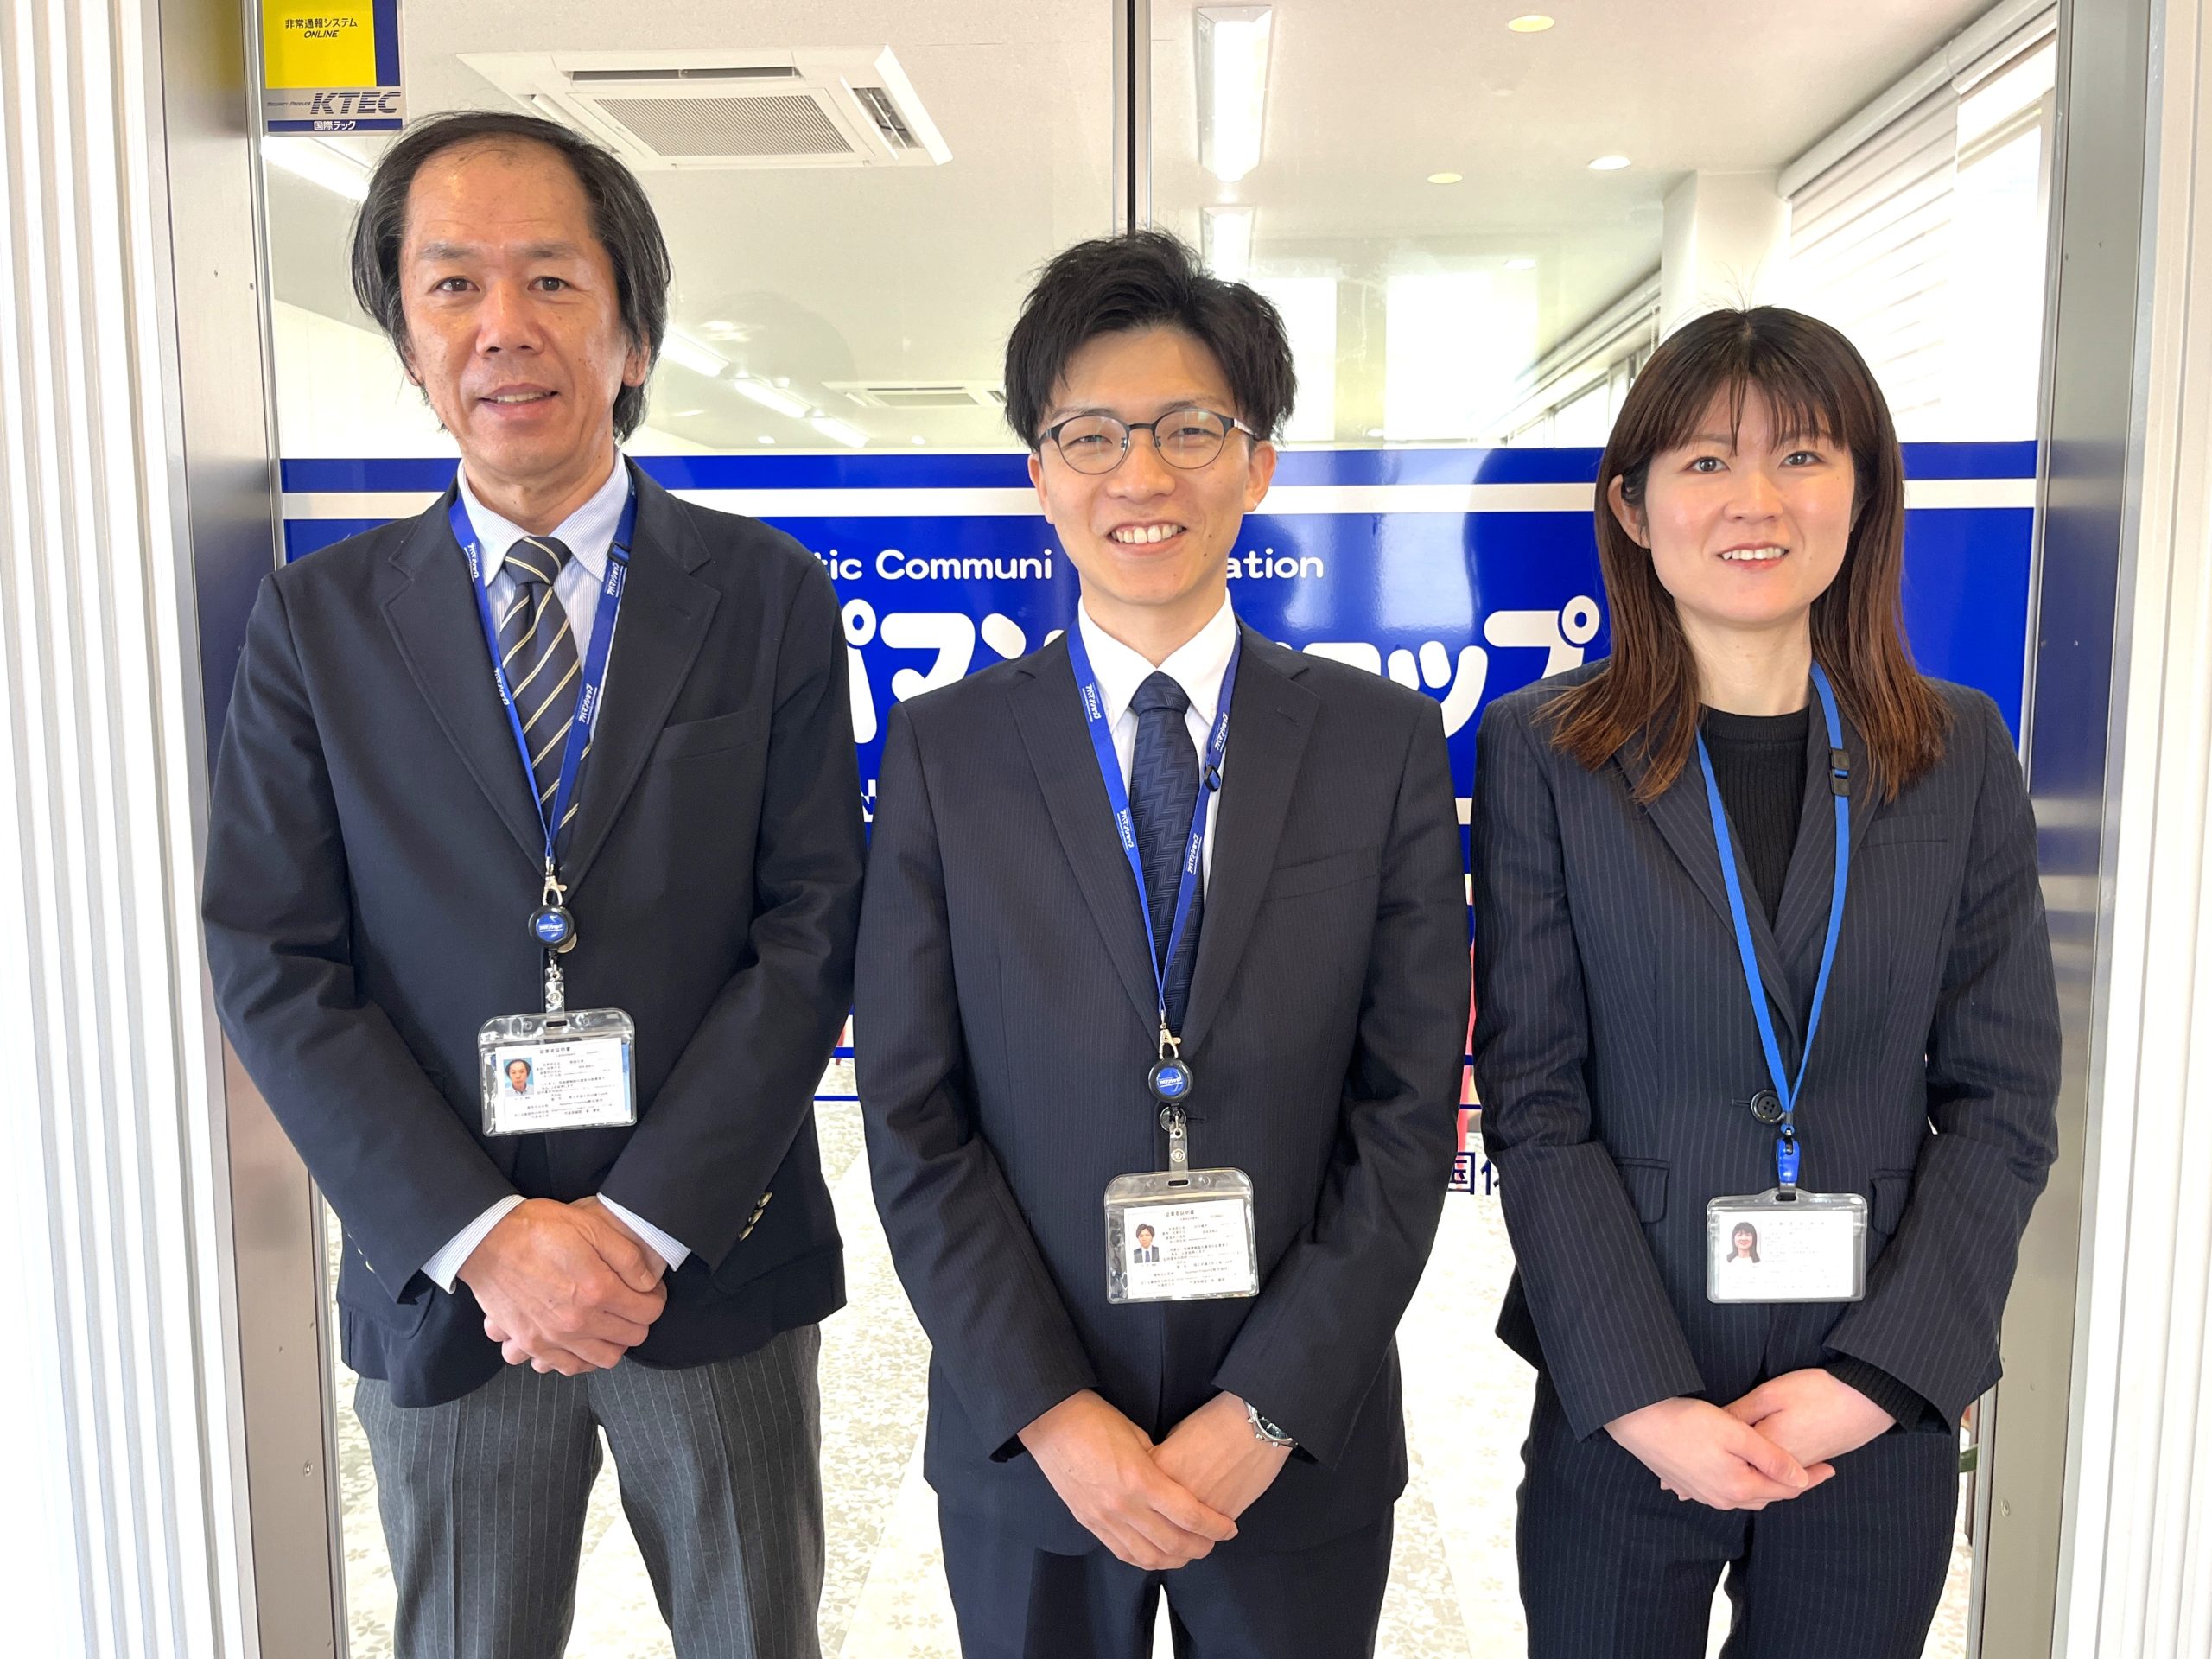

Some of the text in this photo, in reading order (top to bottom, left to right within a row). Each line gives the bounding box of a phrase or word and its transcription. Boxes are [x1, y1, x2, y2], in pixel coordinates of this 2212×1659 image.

[285, 17, 358, 29] 非常通報システム
[310, 92, 402, 115] KTEC
[314, 120, 356, 131] 国際テック
[875, 548, 1052, 580] Communi
[1226, 547, 1324, 579] ation
[579, 683, 594, 723] アパマンショップ
